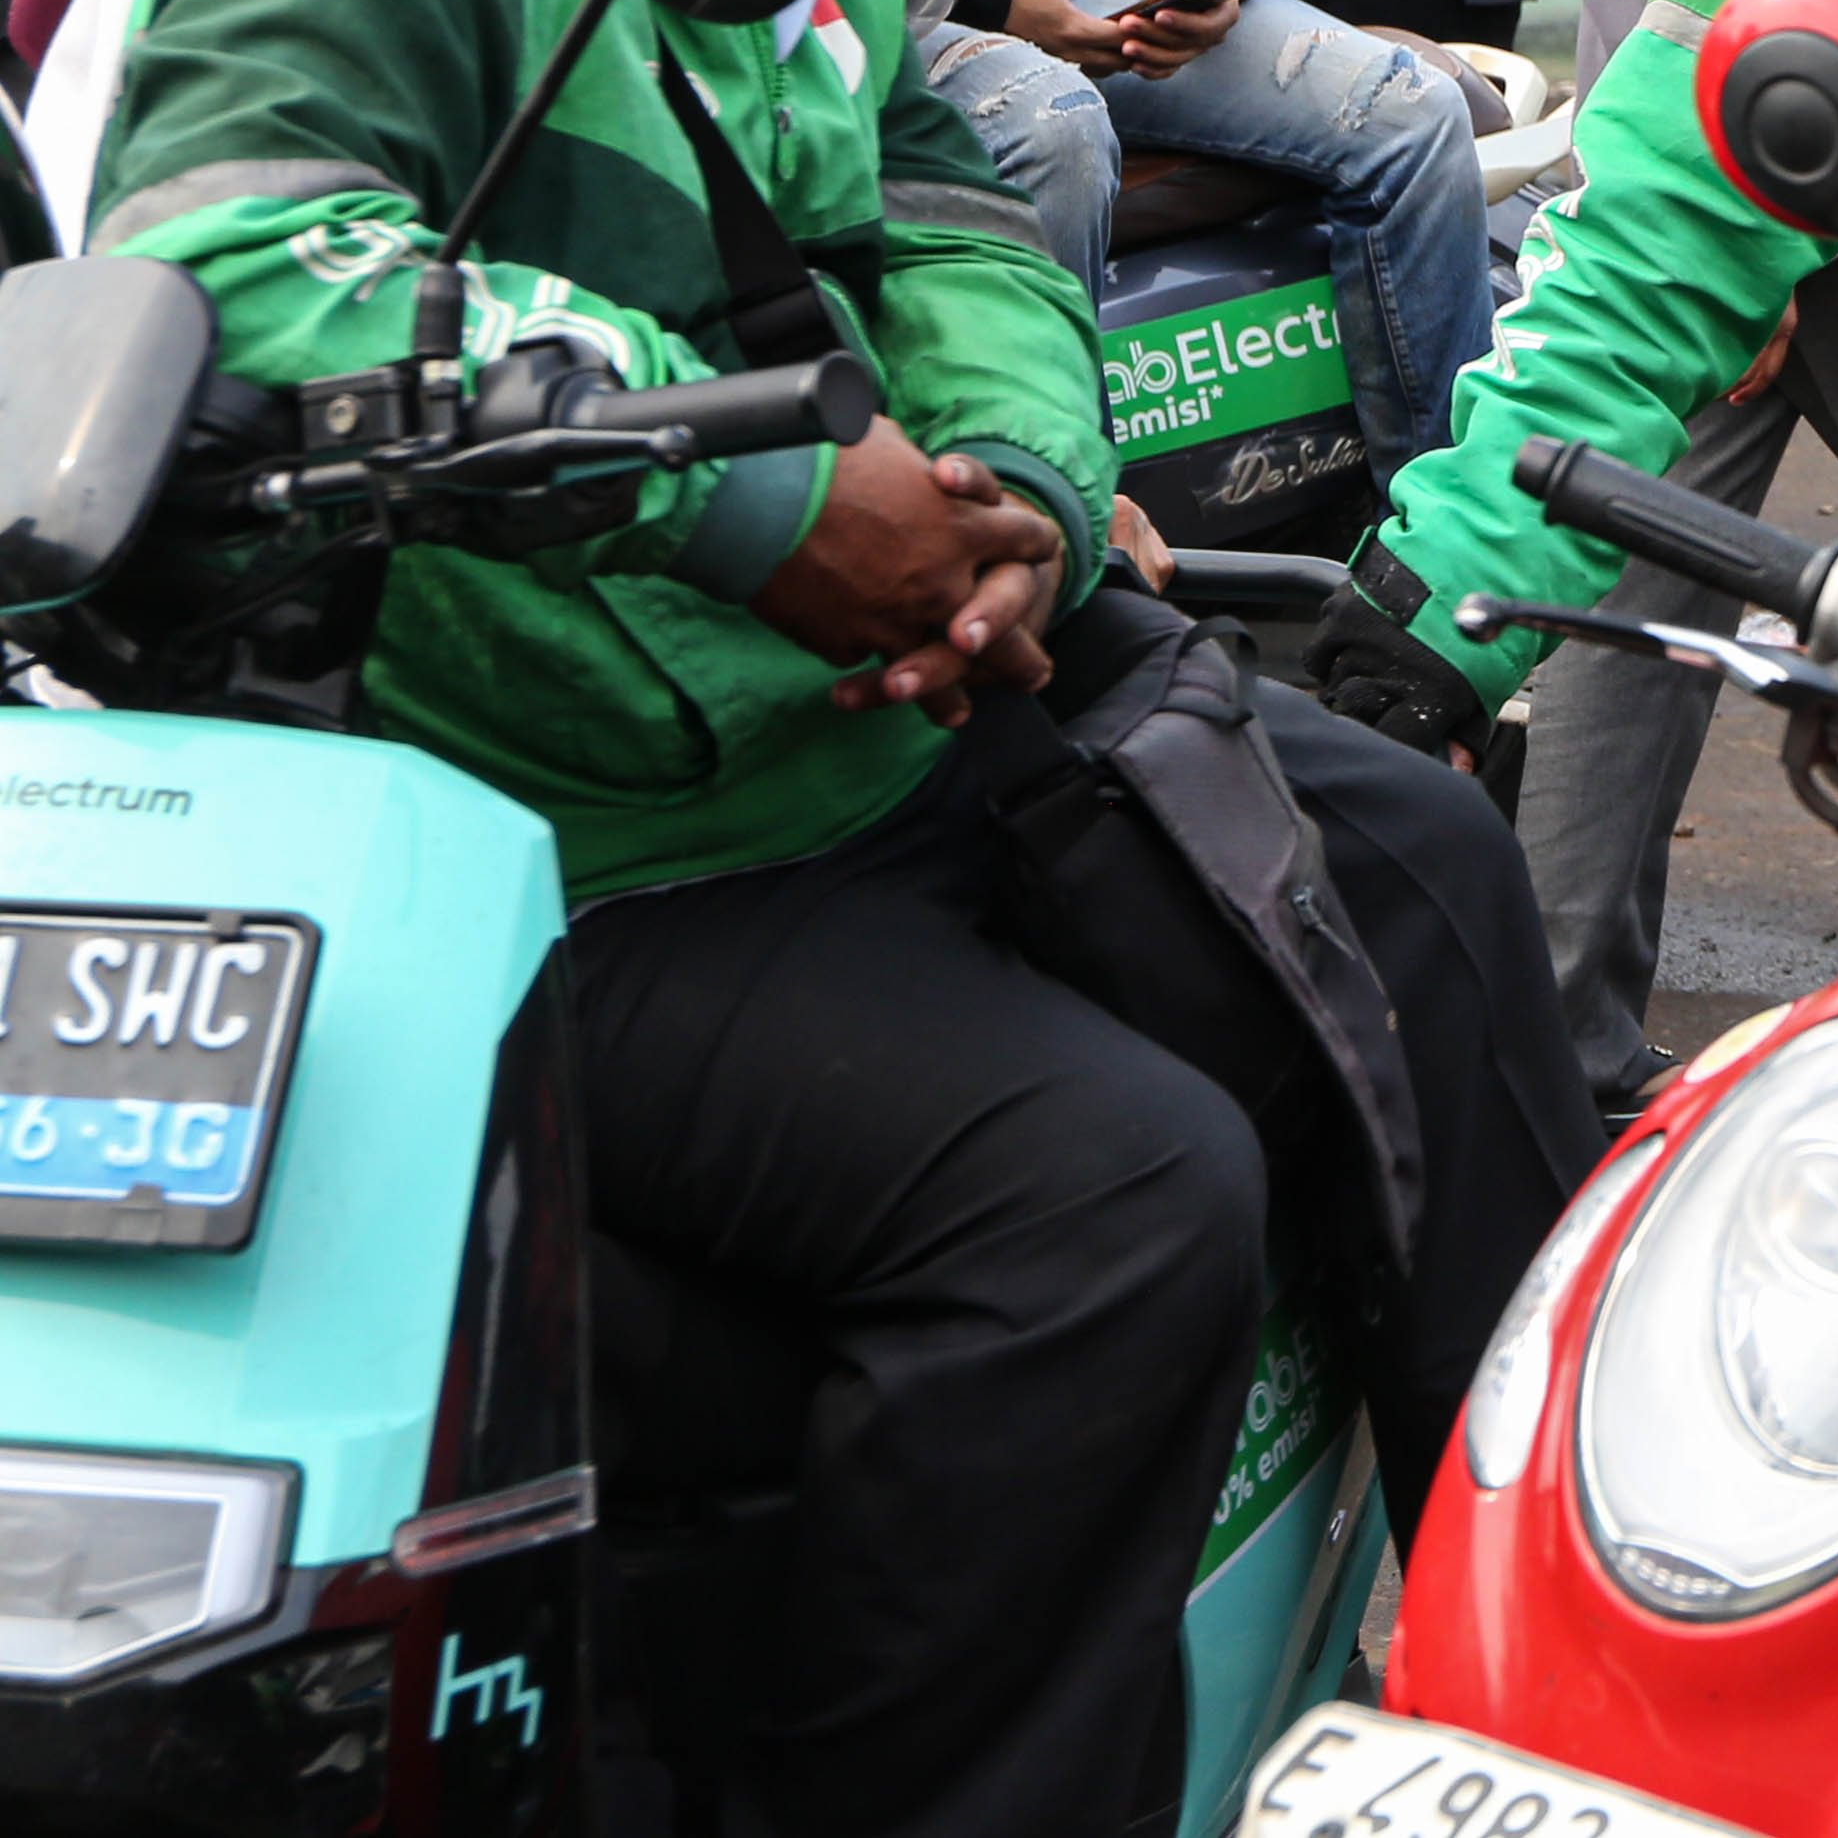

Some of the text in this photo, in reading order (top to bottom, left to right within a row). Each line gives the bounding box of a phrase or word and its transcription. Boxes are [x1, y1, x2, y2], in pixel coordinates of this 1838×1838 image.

[0, 774, 194, 817] lectrum
[54, 937, 267, 1050] SWC
[1259, 1727, 1357, 1813] E
